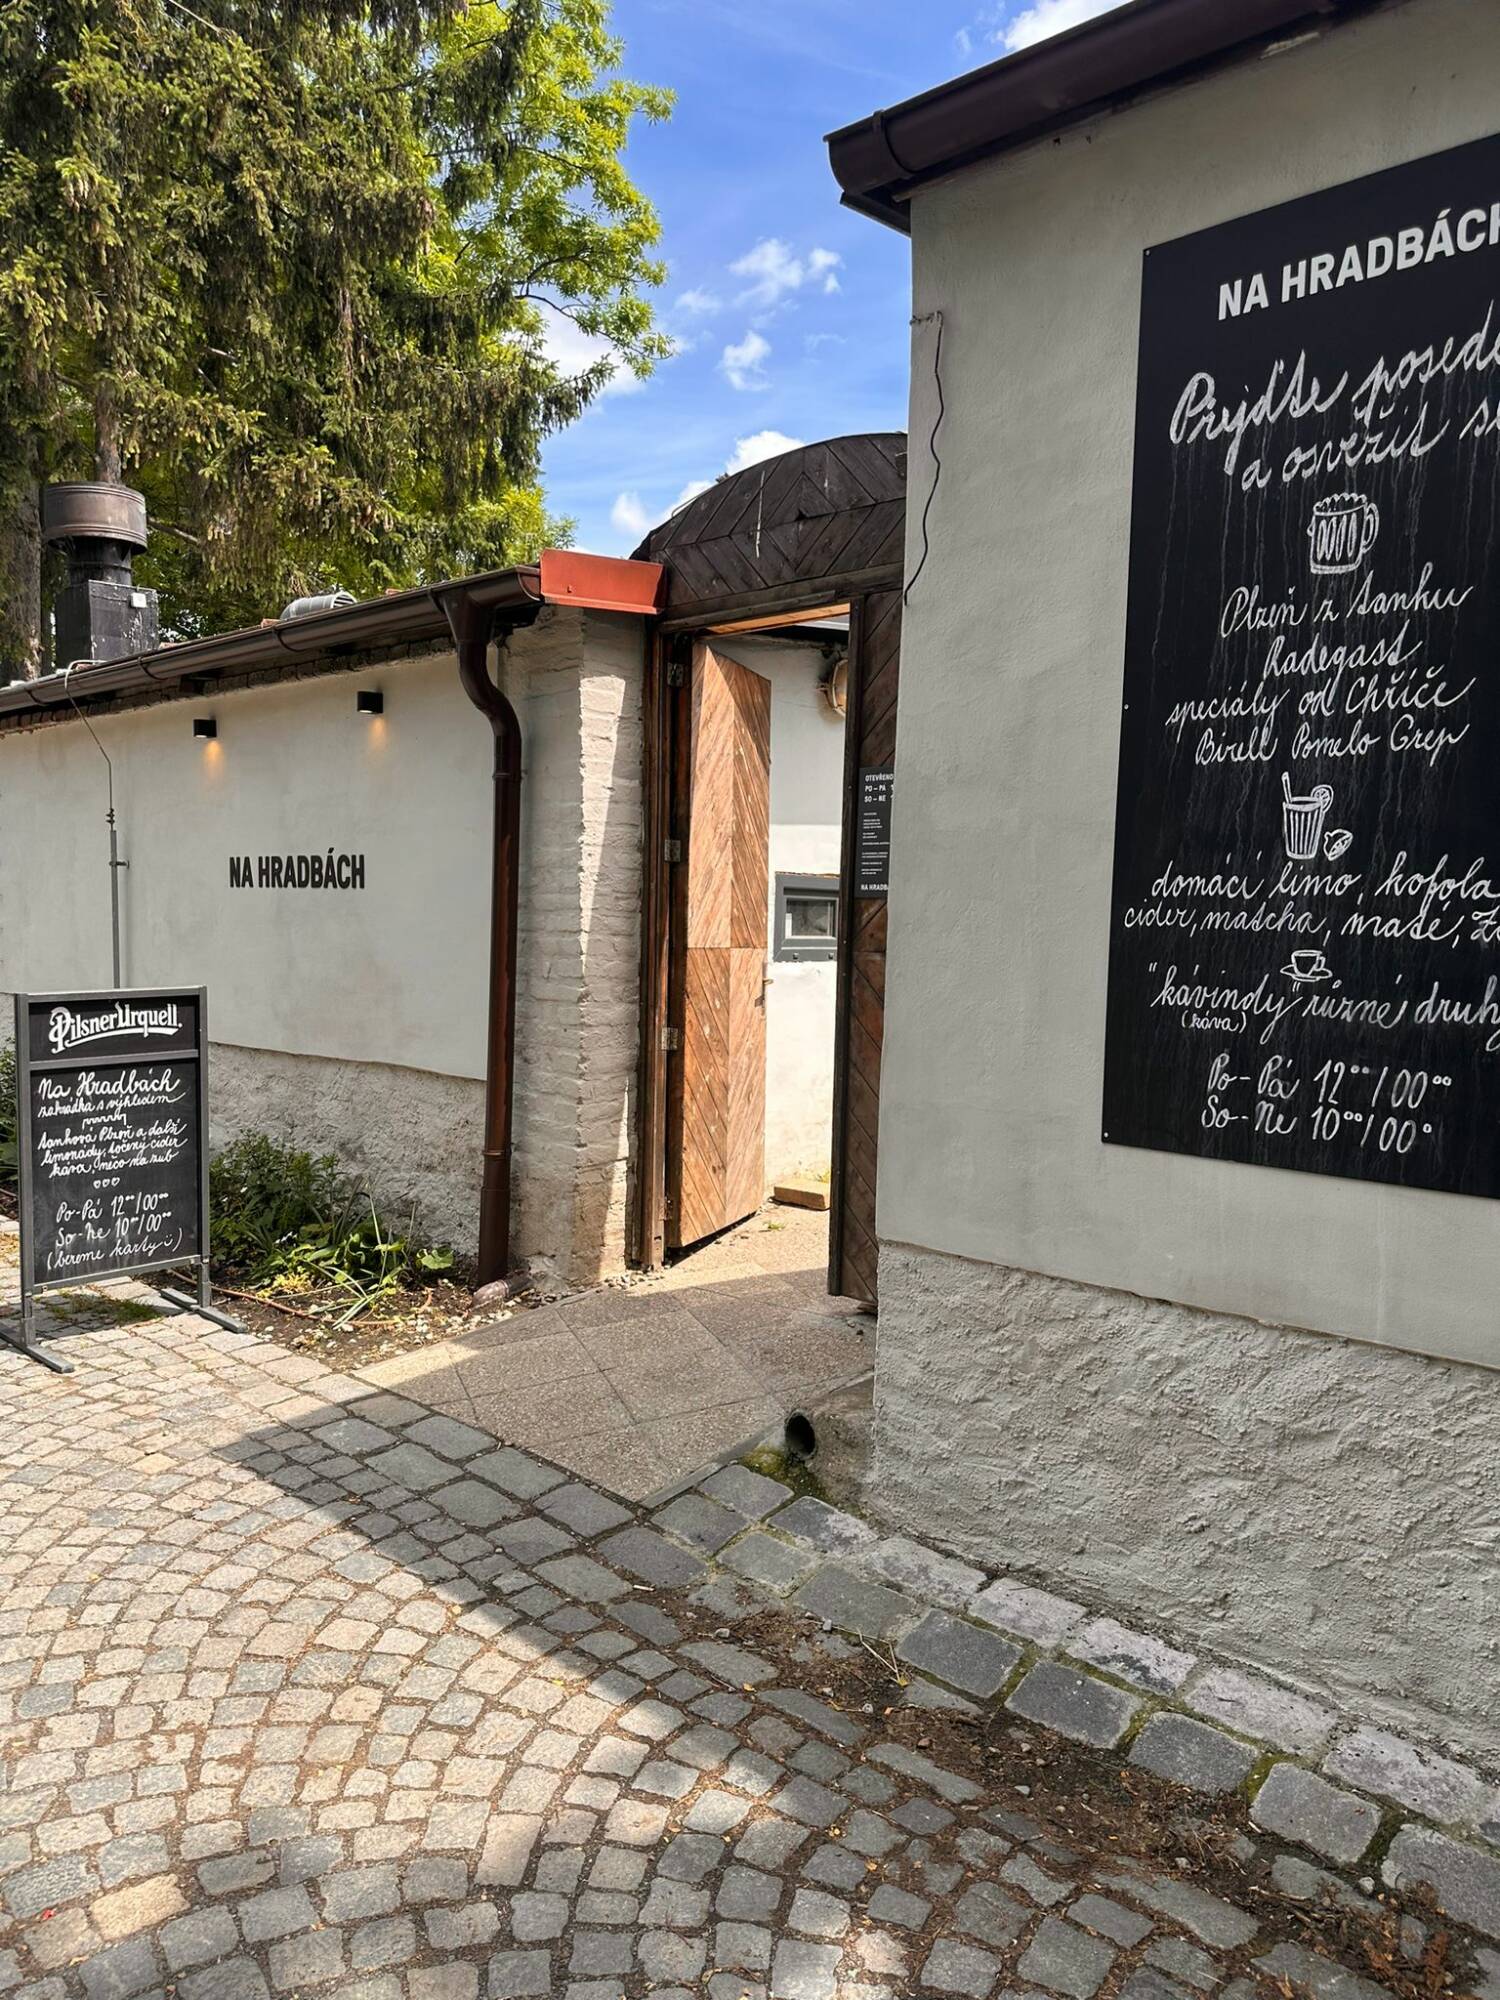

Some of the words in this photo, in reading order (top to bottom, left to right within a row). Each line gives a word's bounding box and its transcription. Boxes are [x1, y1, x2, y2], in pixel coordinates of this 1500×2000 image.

[1218, 274, 1269, 320] NA
[1242, 459, 1272, 491] a
[1221, 584, 1308, 638] Plzeň
[1313, 599, 1340, 622] z
[1346, 562, 1474, 618] tanku
[1262, 619, 1423, 697] Radegast
[1165, 680, 1290, 745] speciály
[1298, 678, 1335, 716] od
[1345, 664, 1477, 714] Chříče
[1195, 726, 1278, 766] Birell
[1292, 718, 1381, 759] Pomelo
[1390, 713, 1471, 767] Grep
[228, 856, 253, 888] NA
[258, 847, 365, 889] HRADBÁCH
[1151, 851, 1265, 899] domácí
[1181, 1010, 1247, 1034] (káva)
[38, 1077, 71, 1099] Na
[76, 1068, 181, 1097] Hradbách
